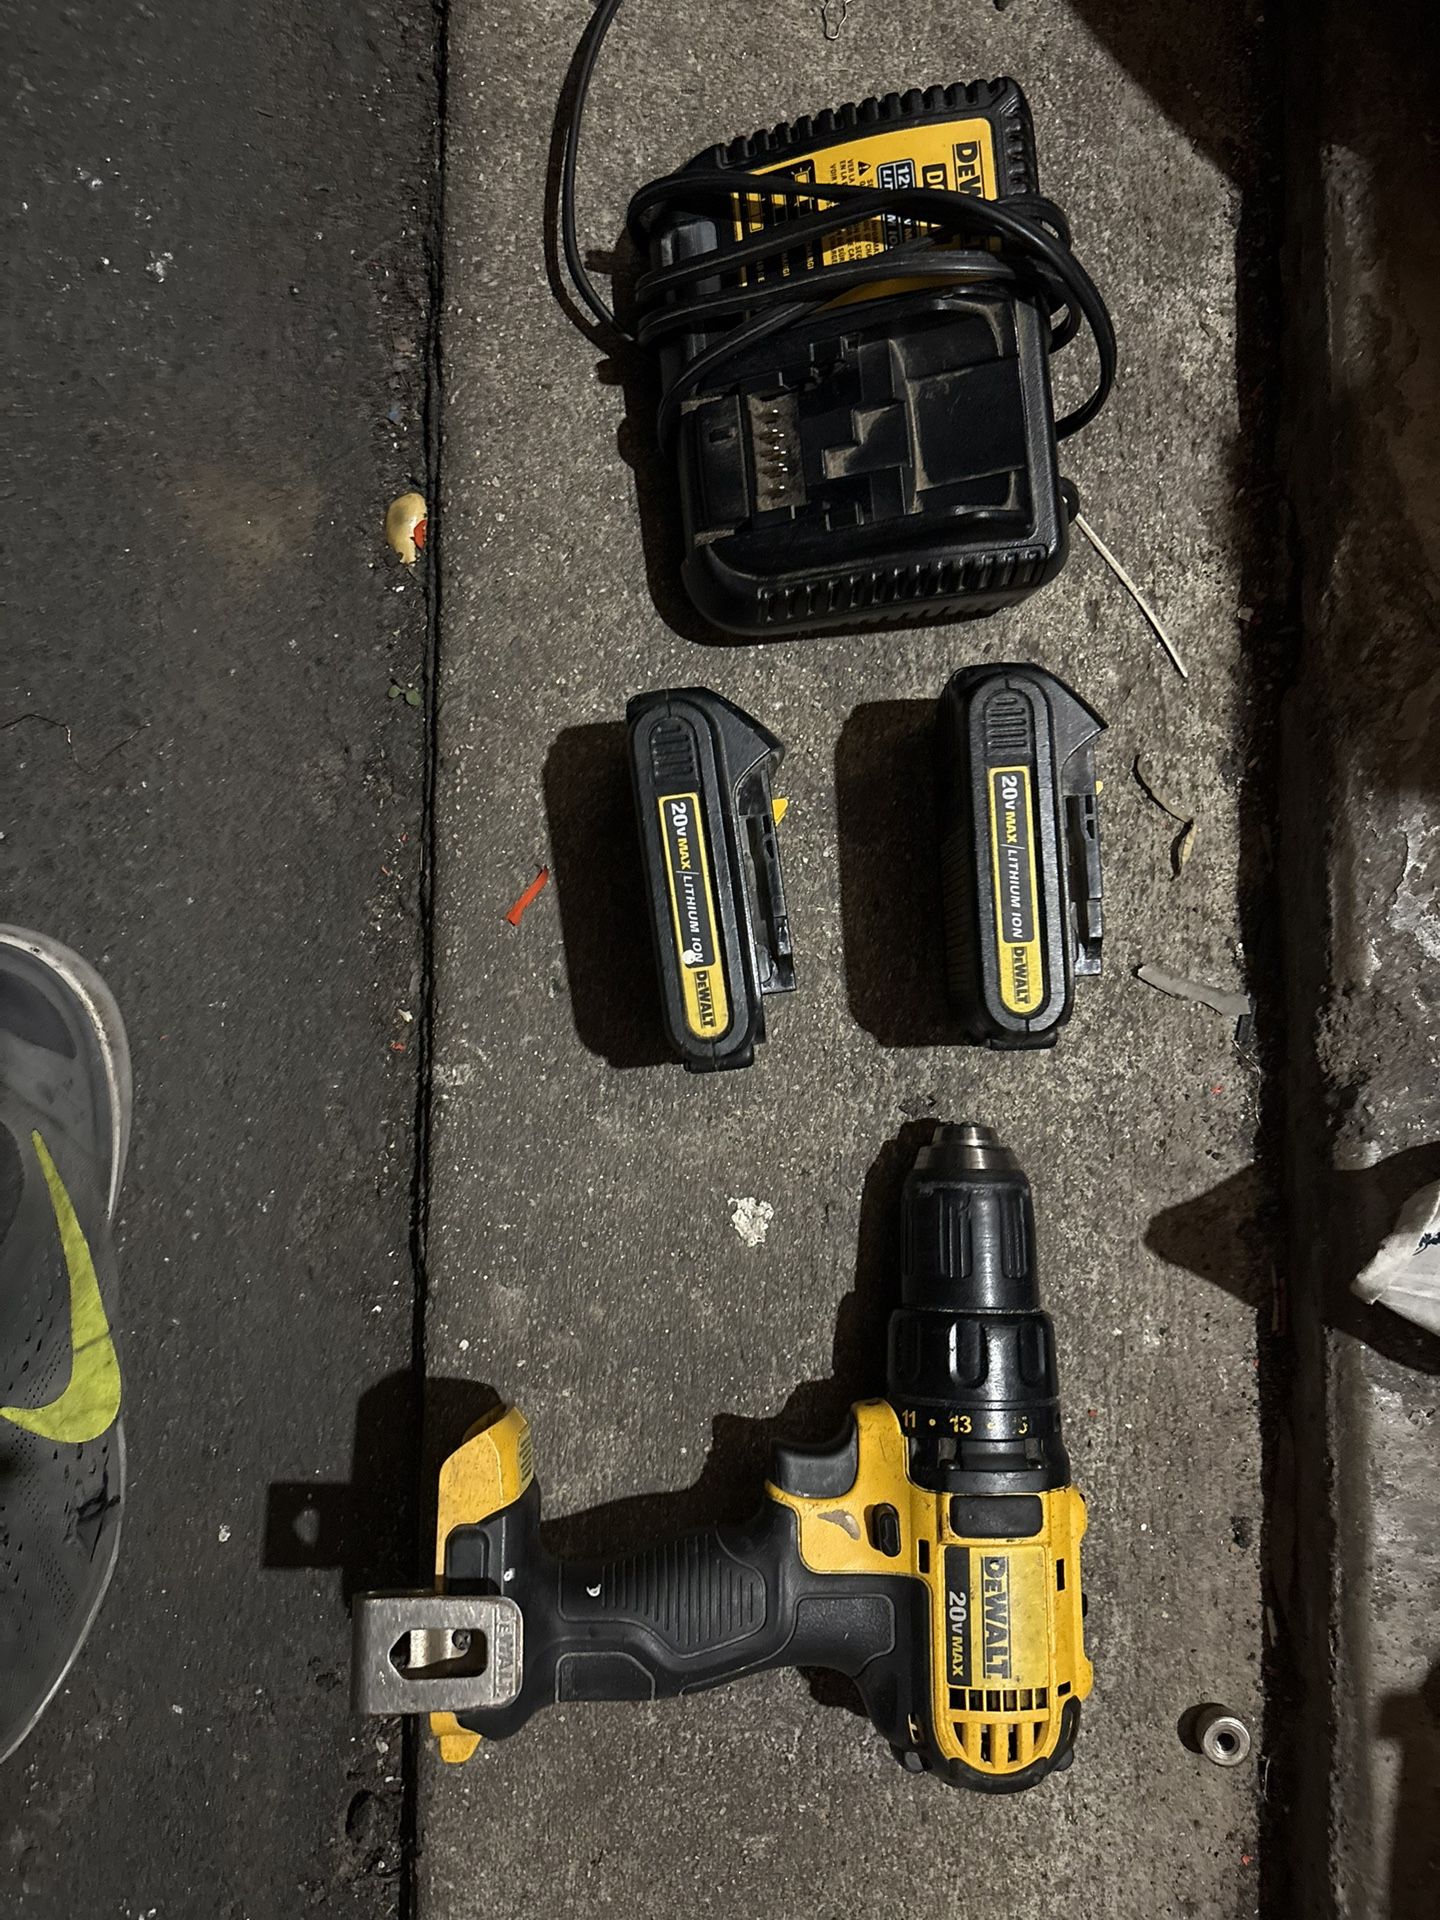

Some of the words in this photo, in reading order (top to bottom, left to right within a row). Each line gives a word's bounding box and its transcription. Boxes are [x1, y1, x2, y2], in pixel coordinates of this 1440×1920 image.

[1005, 811, 1018, 844] MAX
[678, 837, 691, 870] MAX
[1008, 849, 1021, 908] LITHIUM
[683, 875, 700, 933] LITHIUM
[1011, 912, 1023, 938] ION
[692, 938, 704, 963] ION
[1013, 946, 1029, 1004] DEWALT
[696, 970, 715, 1028] DEWALT
[902, 1409, 916, 1428] 11
[949, 1415, 972, 1433] 13
[984, 1556, 1009, 1679] DEWALT
[952, 1635, 964, 1677] MAX
